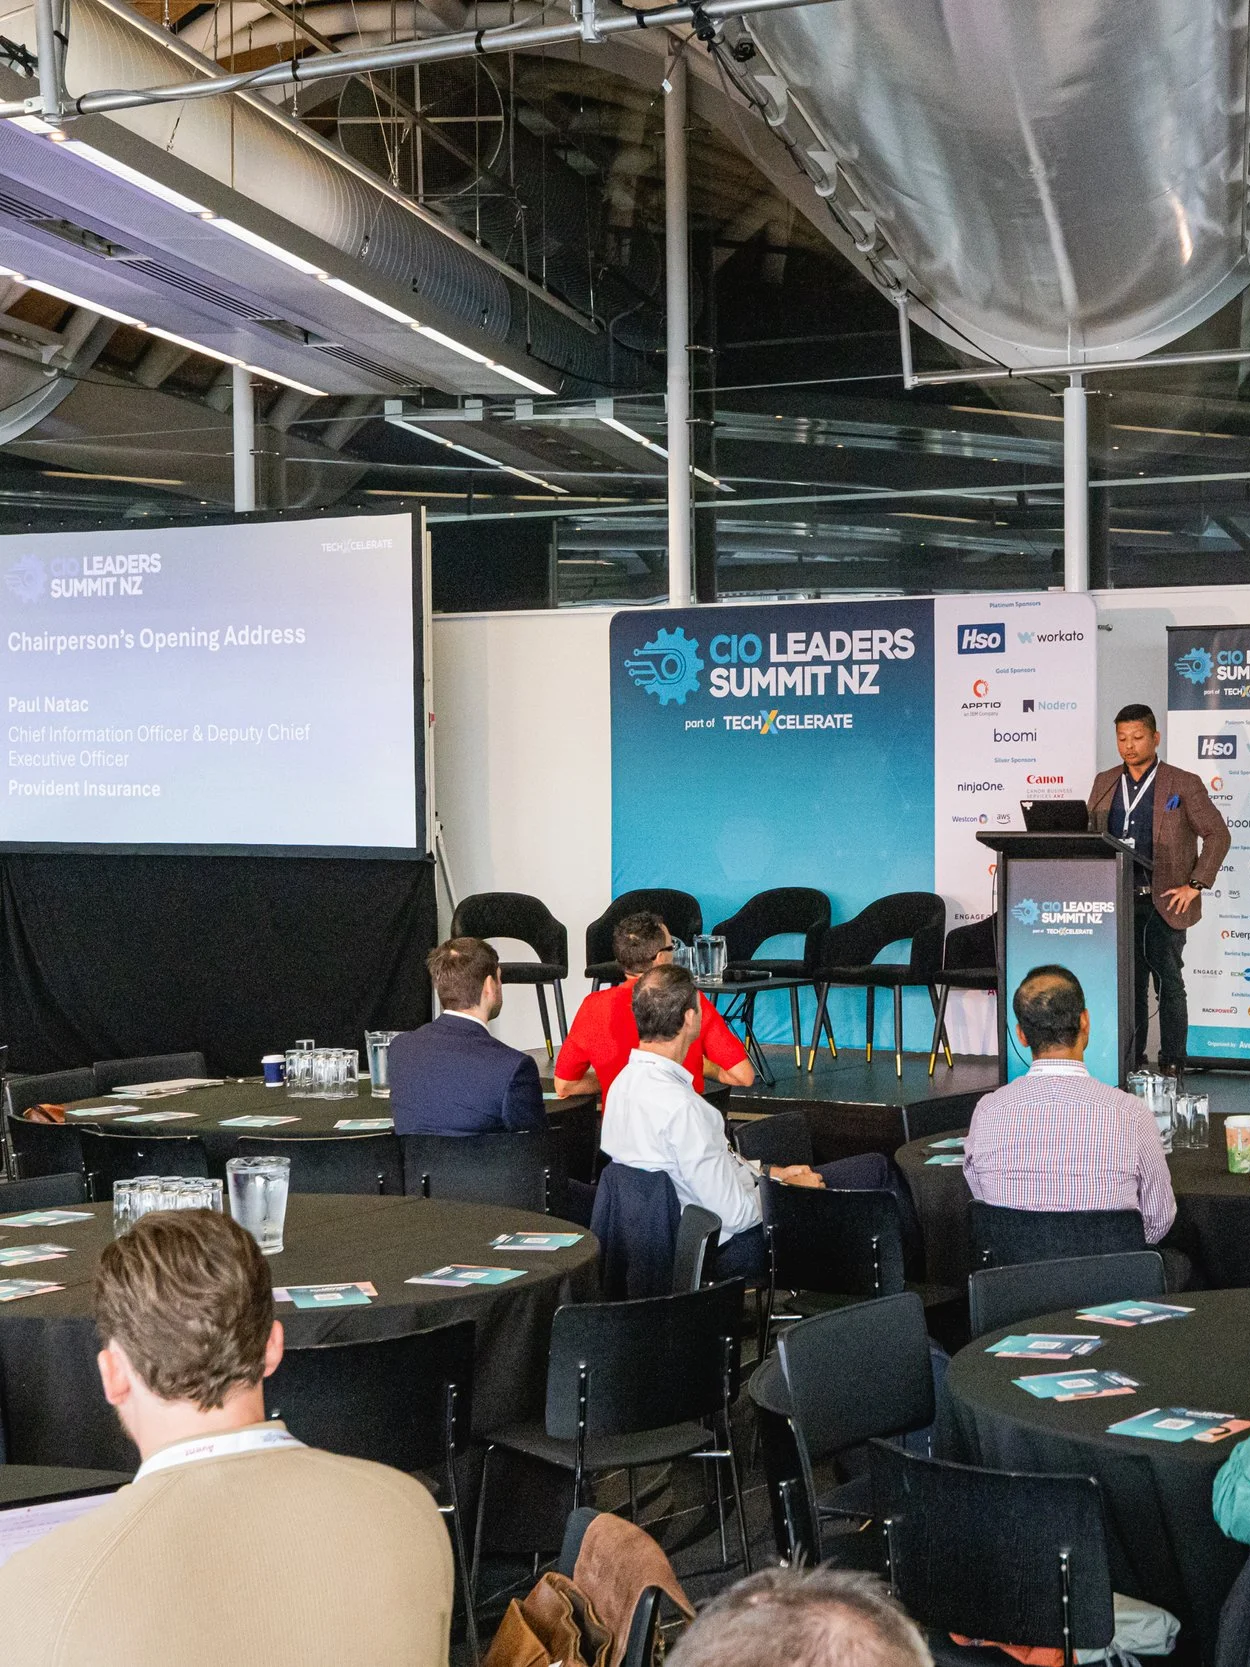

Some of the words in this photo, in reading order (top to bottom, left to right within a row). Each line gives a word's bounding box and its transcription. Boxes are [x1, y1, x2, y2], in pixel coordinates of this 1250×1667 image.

[82, 553, 162, 576] LEADERS
[51, 577, 117, 598] SUMMIT
[120, 576, 143, 596] NZ
[140, 626, 220, 652] Opening
[224, 624, 306, 646] Address
[1037, 630, 1084, 643] workato
[710, 634, 762, 664] CIO
[770, 628, 915, 662] LEADERS
[1217, 650, 1244, 665] CIO
[709, 666, 830, 699] SUMMIT
[838, 664, 880, 695] NZ
[8, 697, 40, 713] Paul
[44, 697, 89, 713] Natac
[961, 702, 1001, 710] APPTIO
[685, 719, 704, 731] part
[706, 718, 715, 728] of
[724, 710, 853, 734] TECHXCELERATE
[8, 725, 47, 744] Chief
[49, 725, 133, 744] Information
[137, 725, 188, 742] Officer
[193, 725, 204, 741] &
[208, 724, 263, 746] Deputy
[268, 723, 311, 741] Chief
[994, 728, 1037, 743] boomi
[8, 750, 76, 768] Executive
[80, 750, 129, 768] Officer
[1026, 774, 1064, 784] Canon
[8, 780, 80, 798] Provident
[84, 781, 161, 798] Insurance
[951, 815, 978, 823] Westcon
[1042, 901, 1061, 912] CIO
[1063, 901, 1115, 912] LEADERS
[1041, 913, 1085, 923] SUMMIT
[1087, 913, 1103, 923] NZ
